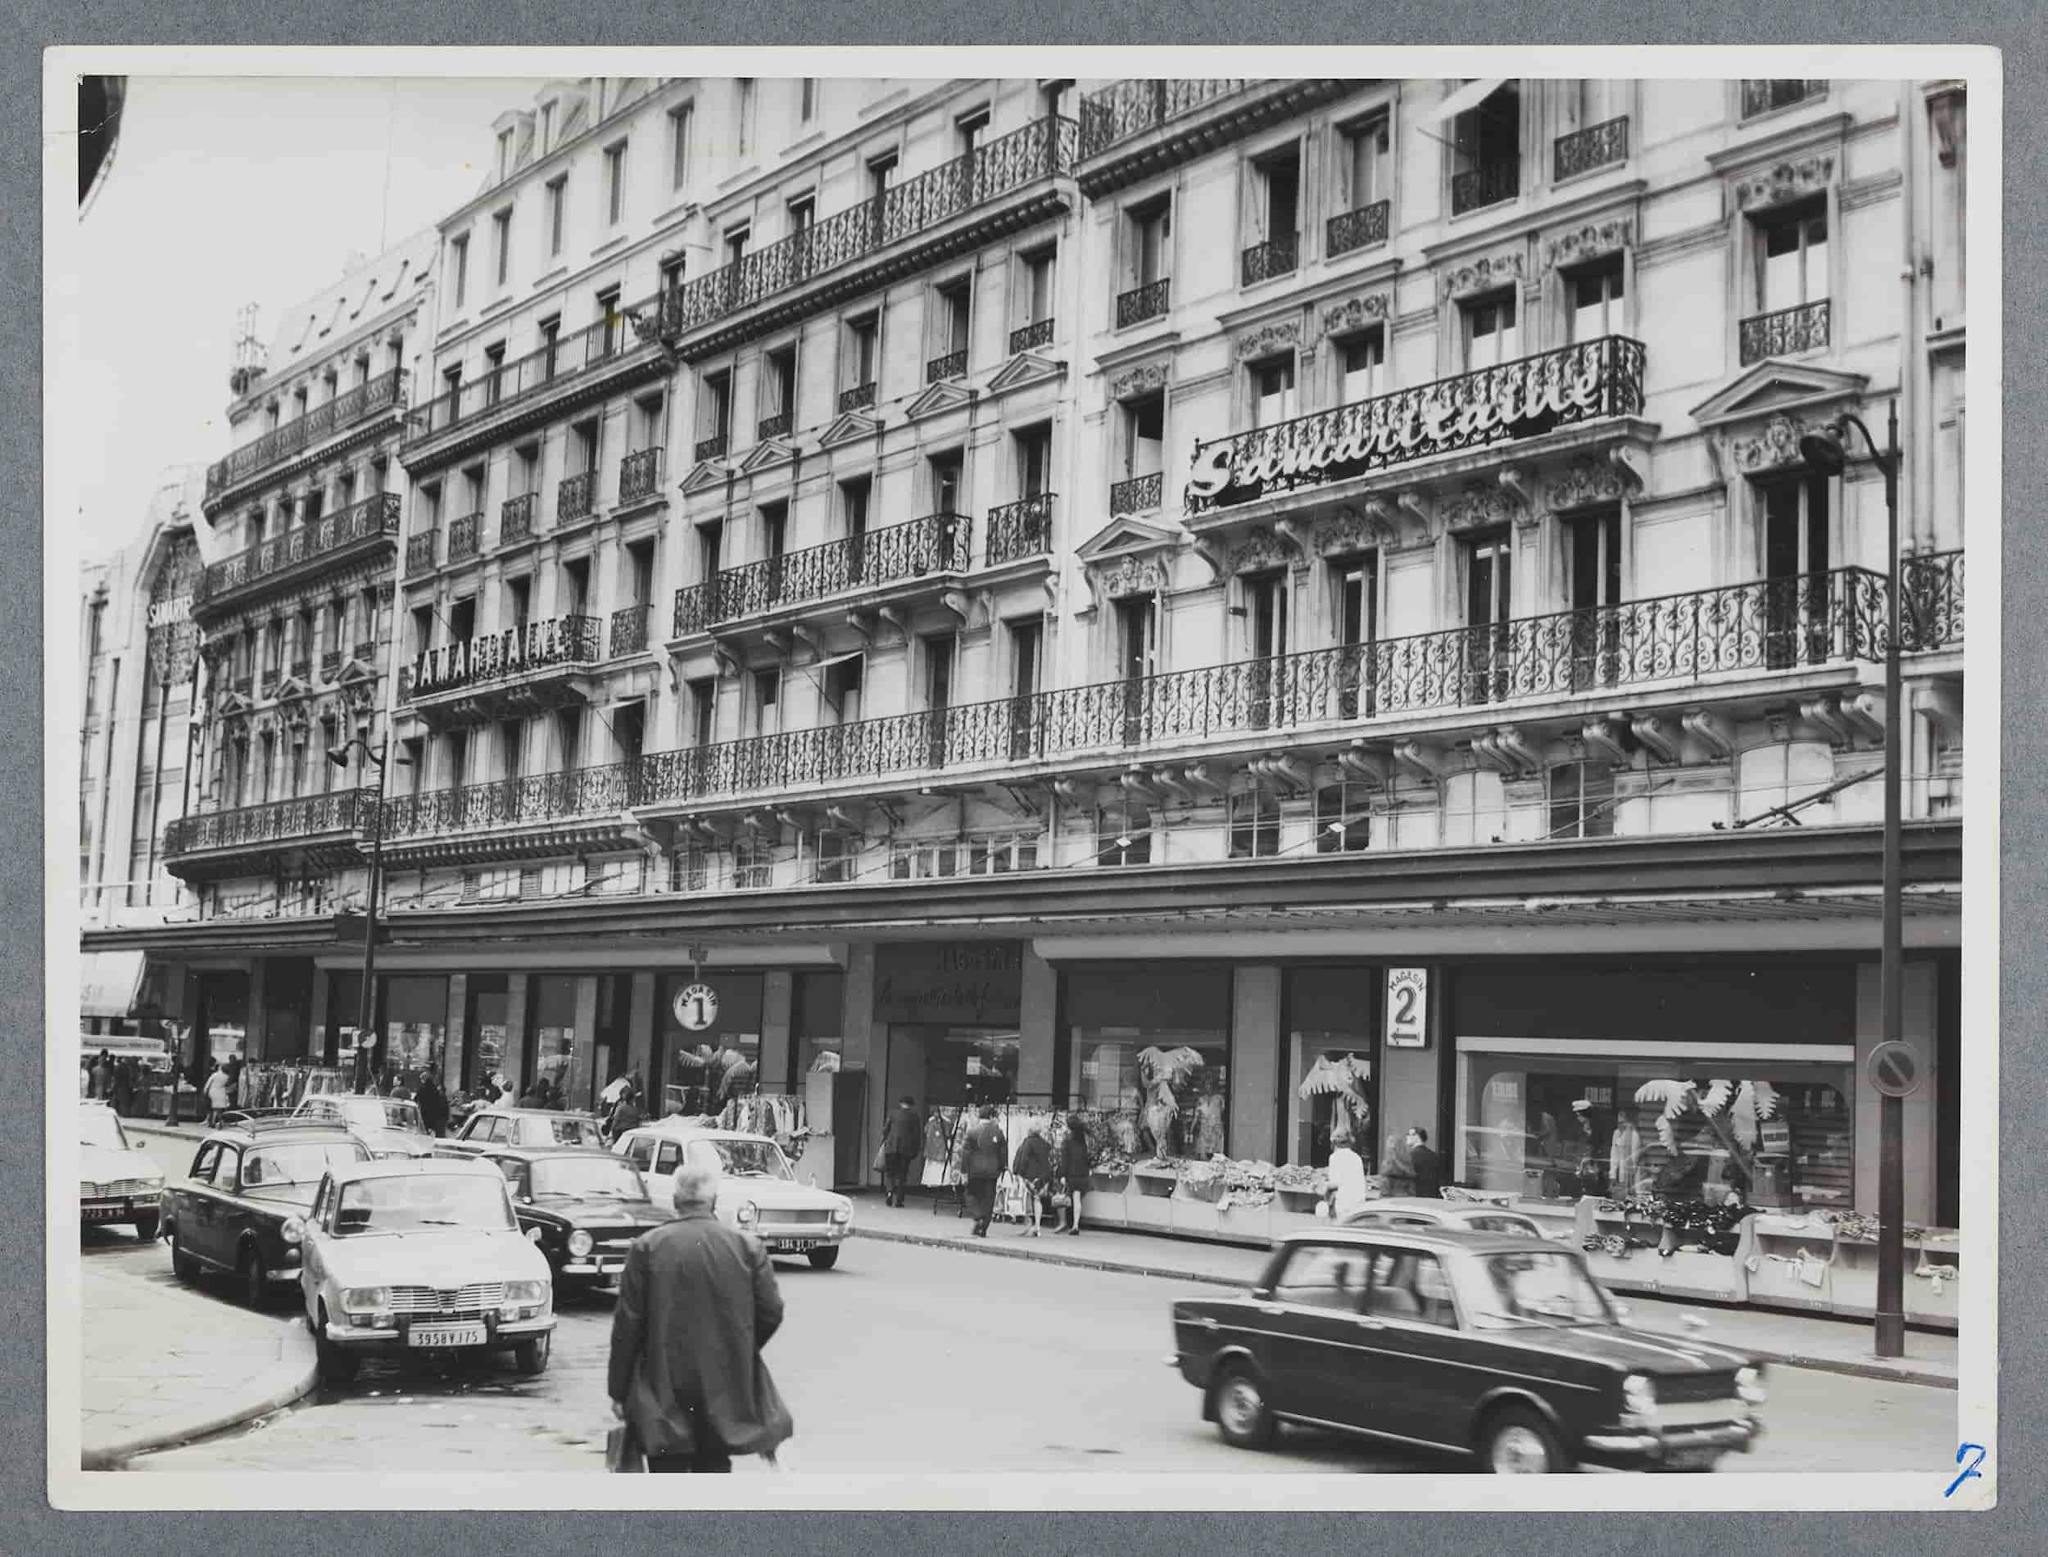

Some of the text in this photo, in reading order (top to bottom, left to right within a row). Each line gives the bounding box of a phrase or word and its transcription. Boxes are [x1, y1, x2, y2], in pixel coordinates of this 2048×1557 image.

[1187, 372, 1600, 498] Samaritaine
[681, 986, 718, 1008] MAGASIN
[1389, 970, 1425, 992] MAGASIN
[692, 997, 708, 1026] 1
[1395, 986, 1417, 1025] 2
[1944, 1442, 1987, 1498] 7
